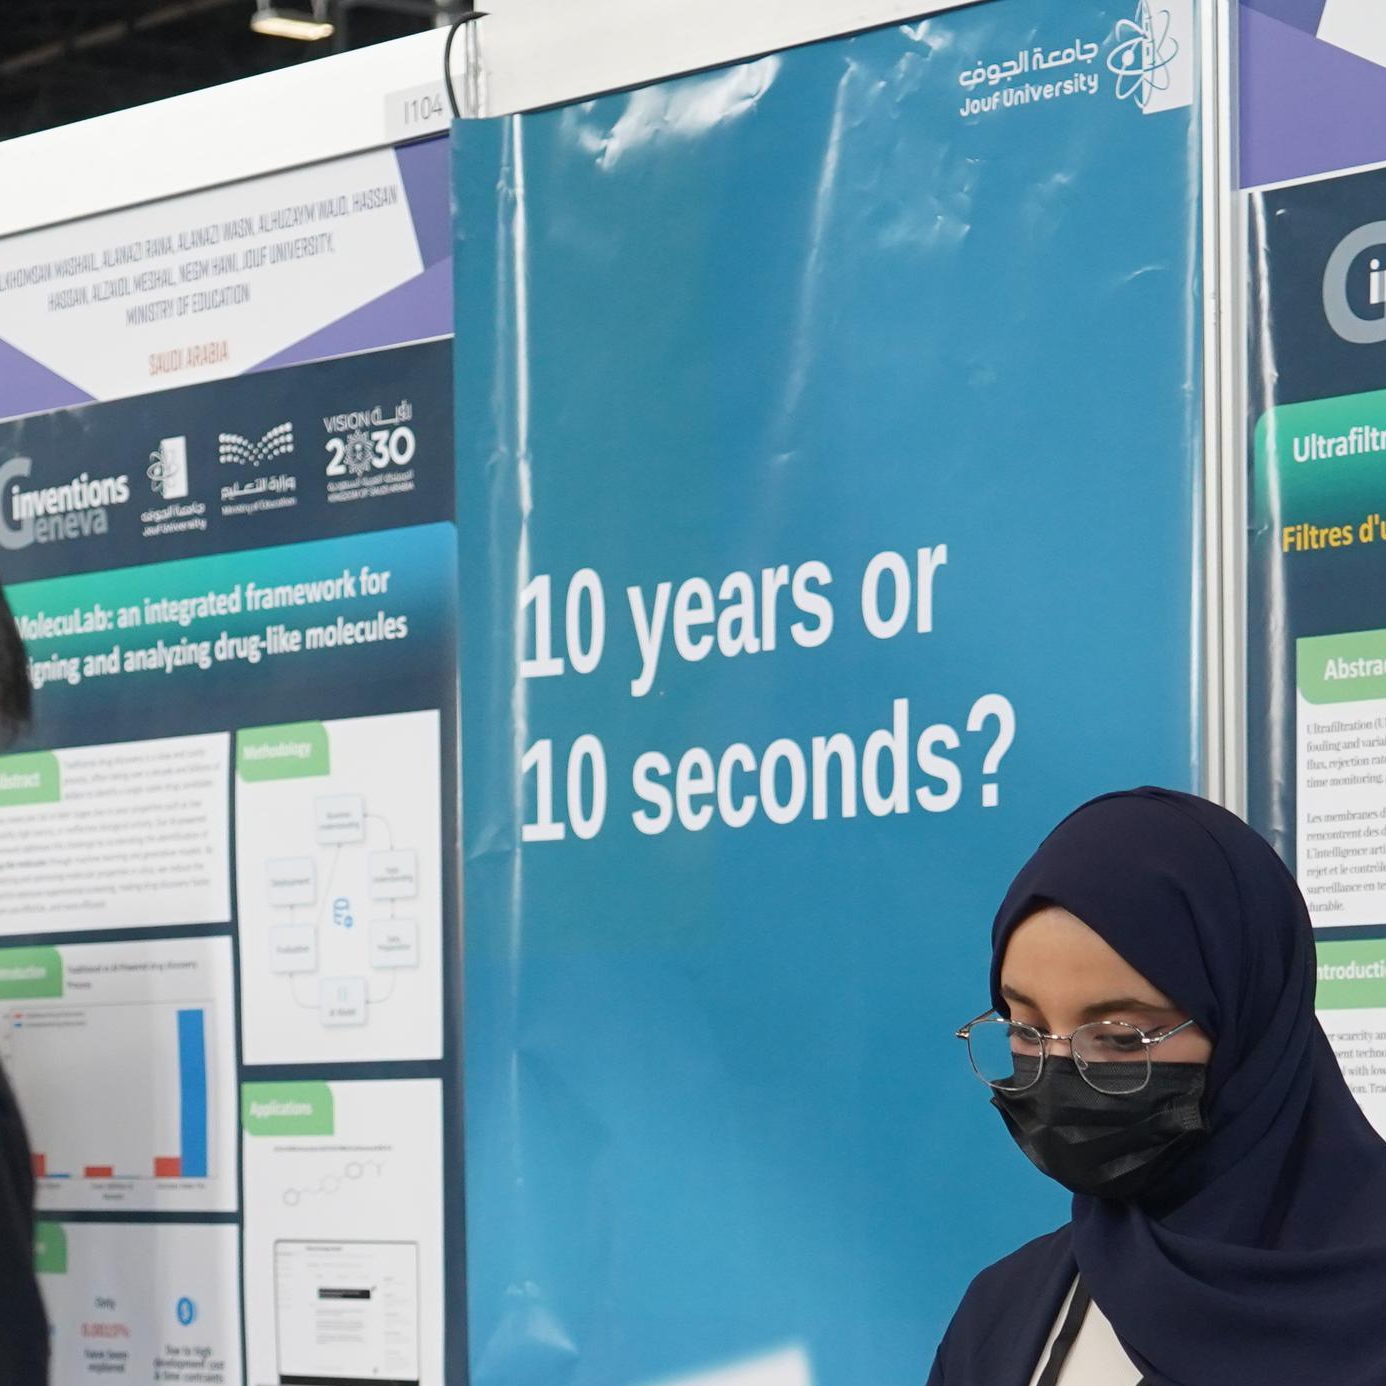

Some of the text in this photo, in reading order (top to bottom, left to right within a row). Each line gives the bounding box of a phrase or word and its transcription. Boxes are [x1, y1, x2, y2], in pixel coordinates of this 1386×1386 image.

[958, 38, 1099, 91] جامعة الجوف
[959, 72, 1099, 117] Jouf University
[126, 282, 250, 326] MINISTRY OF EDUCATION
[149, 341, 230, 376] SAUDI ARABIA
[323, 410, 371, 434] VISION
[11, 472, 130, 521] inventions
[1282, 520, 1353, 553] Filtres
[117, 604, 142, 628] an
[144, 585, 242, 628] integrated
[245, 569, 356, 608] framework
[359, 565, 391, 596] for
[518, 541, 948, 699] 10 years or
[29, 610, 408, 690] igning and analyzing drug-like molecules
[241, 740, 312, 762] Methodology
[1307, 742, 1340, 753] fouling
[1342, 738, 1360, 749] and
[520, 693, 1018, 843] 10 seconds?
[1337, 1030, 1373, 1044] scarcity
[249, 1101, 314, 1120] Applications
